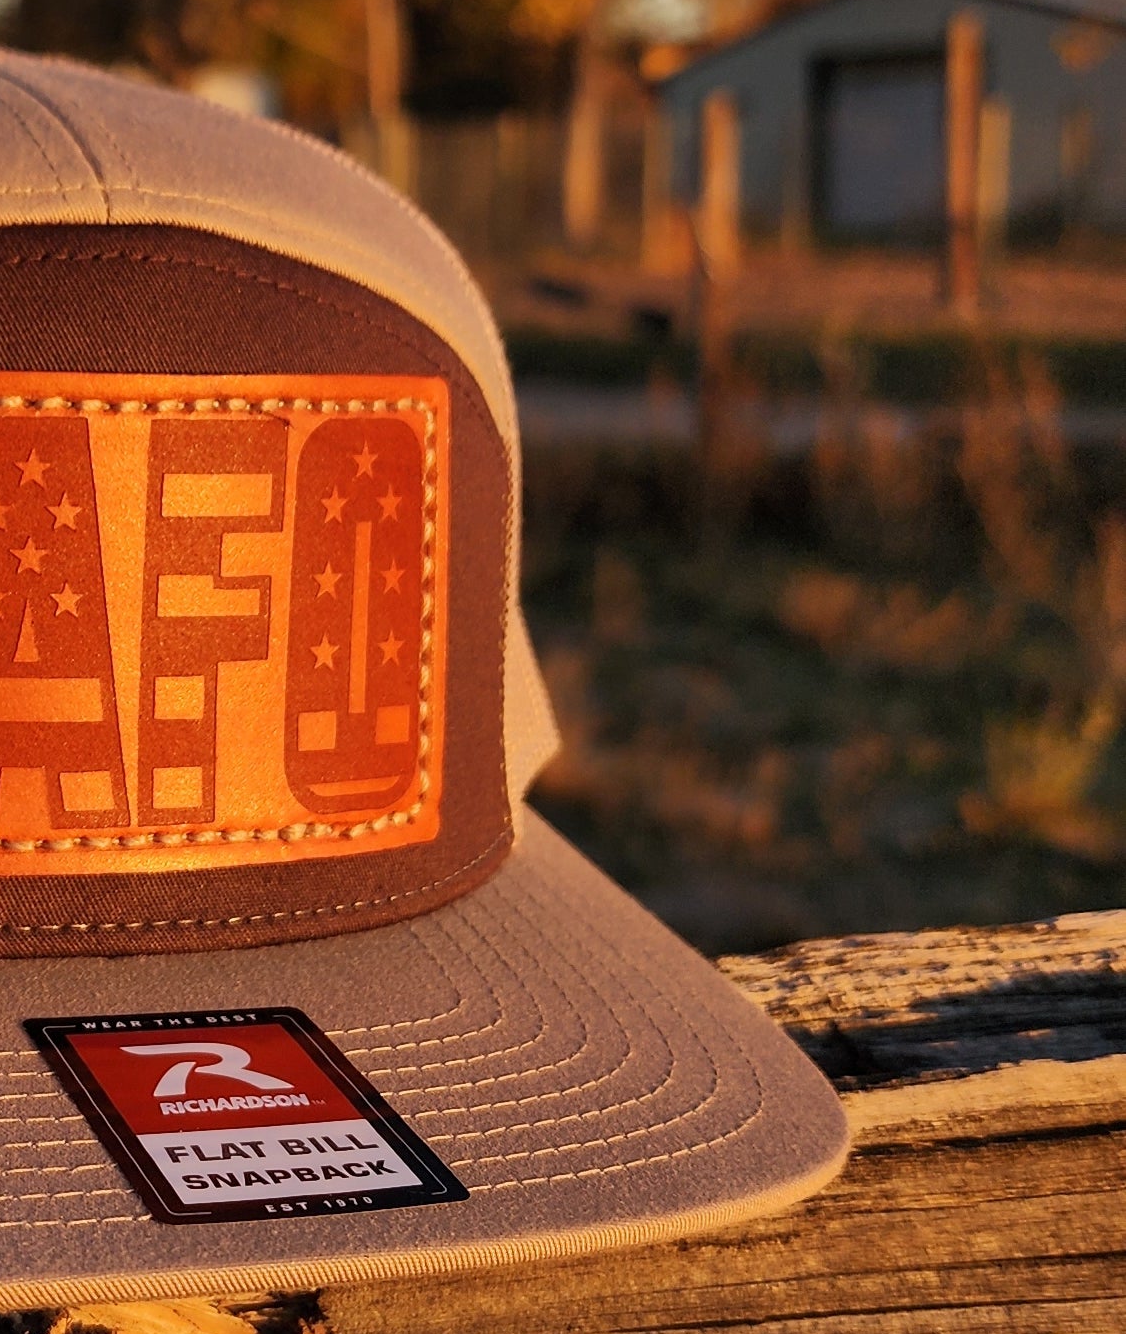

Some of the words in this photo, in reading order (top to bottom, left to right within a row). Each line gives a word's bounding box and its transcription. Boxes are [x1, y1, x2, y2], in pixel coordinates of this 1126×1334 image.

[81, 1020, 142, 1029] WEAR
[153, 1017, 195, 1026] THE
[205, 1013, 257, 1023] BEST
[160, 1093, 310, 1115] RICHARDSON
[164, 1140, 266, 1163] FLAT
[277, 1133, 379, 1156] BILL
[181, 1159, 398, 1190] SNAPBACK
[264, 1201, 308, 1213] EST
[323, 1196, 373, 1208] 1970
